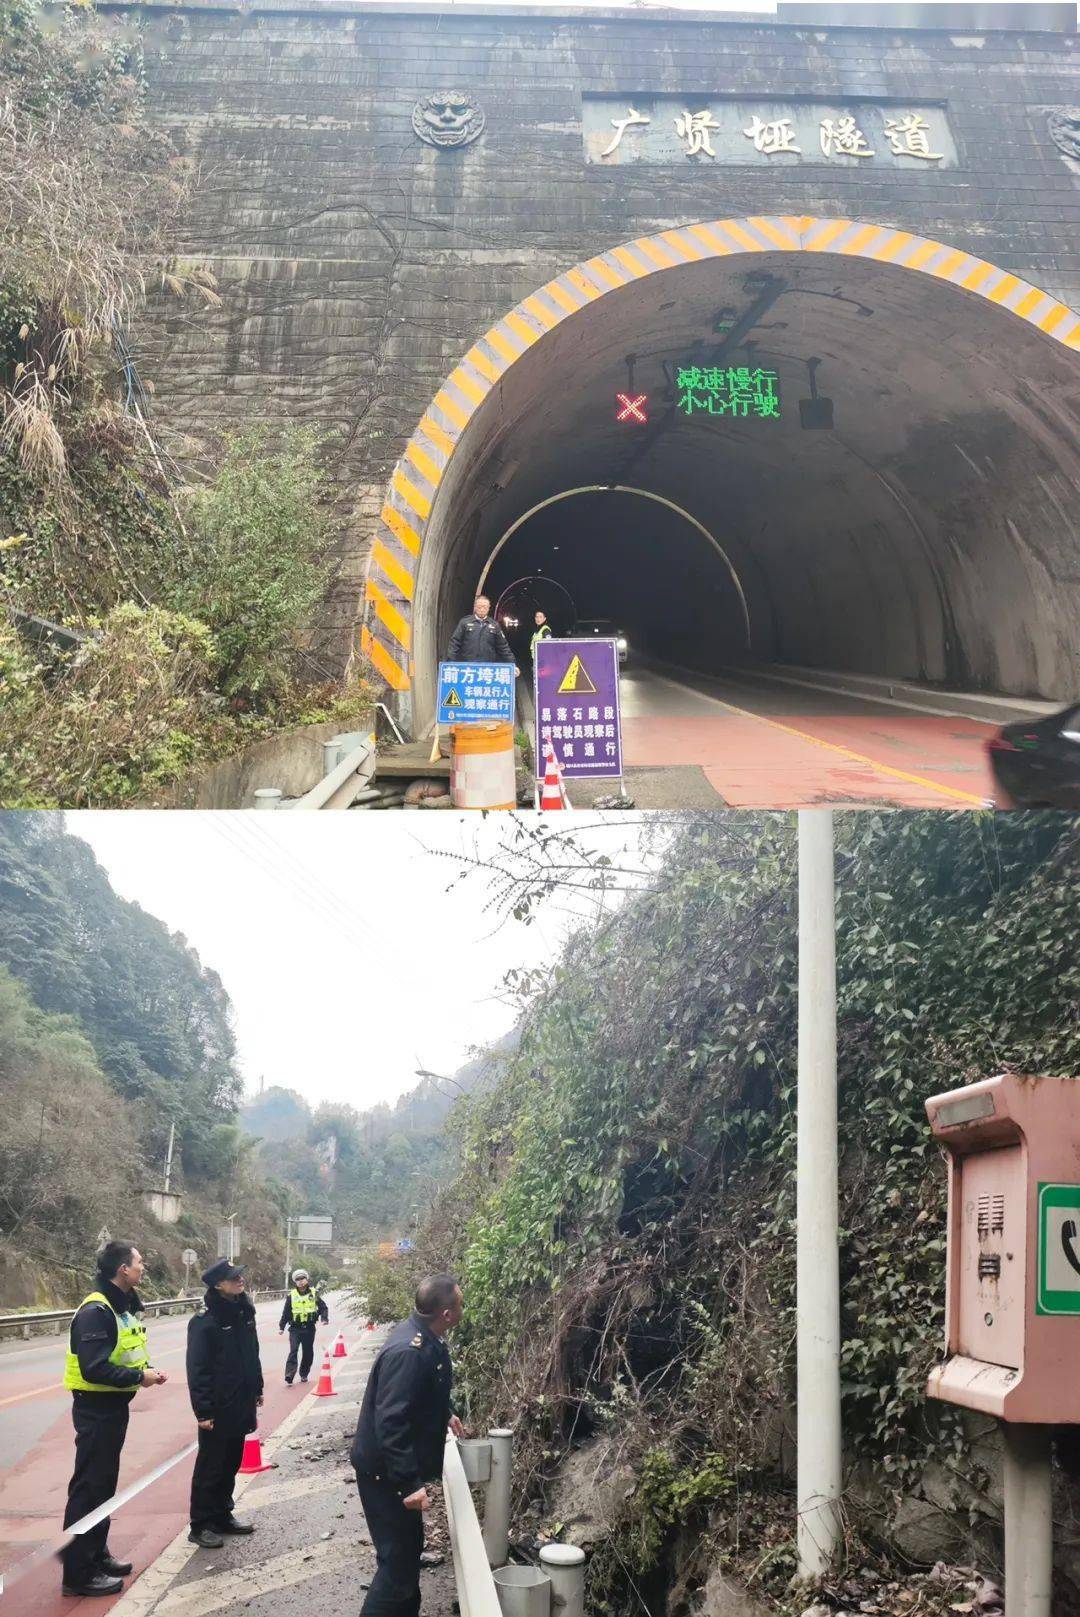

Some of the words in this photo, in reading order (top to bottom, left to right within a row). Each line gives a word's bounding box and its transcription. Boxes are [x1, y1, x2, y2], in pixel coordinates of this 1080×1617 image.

[601, 108, 944, 160] 广贤垭隧道
[677, 366, 778, 391] 减速慢行
[677, 390, 781, 417] 小心行驶
[442, 666, 511, 685] 前方垮塌
[464, 686, 510, 698] 车辆及行人
[464, 698, 510, 710] 观察通行
[541, 706, 615, 721] 易落石路段
[541, 724, 615, 739] 请驾驶员观察后
